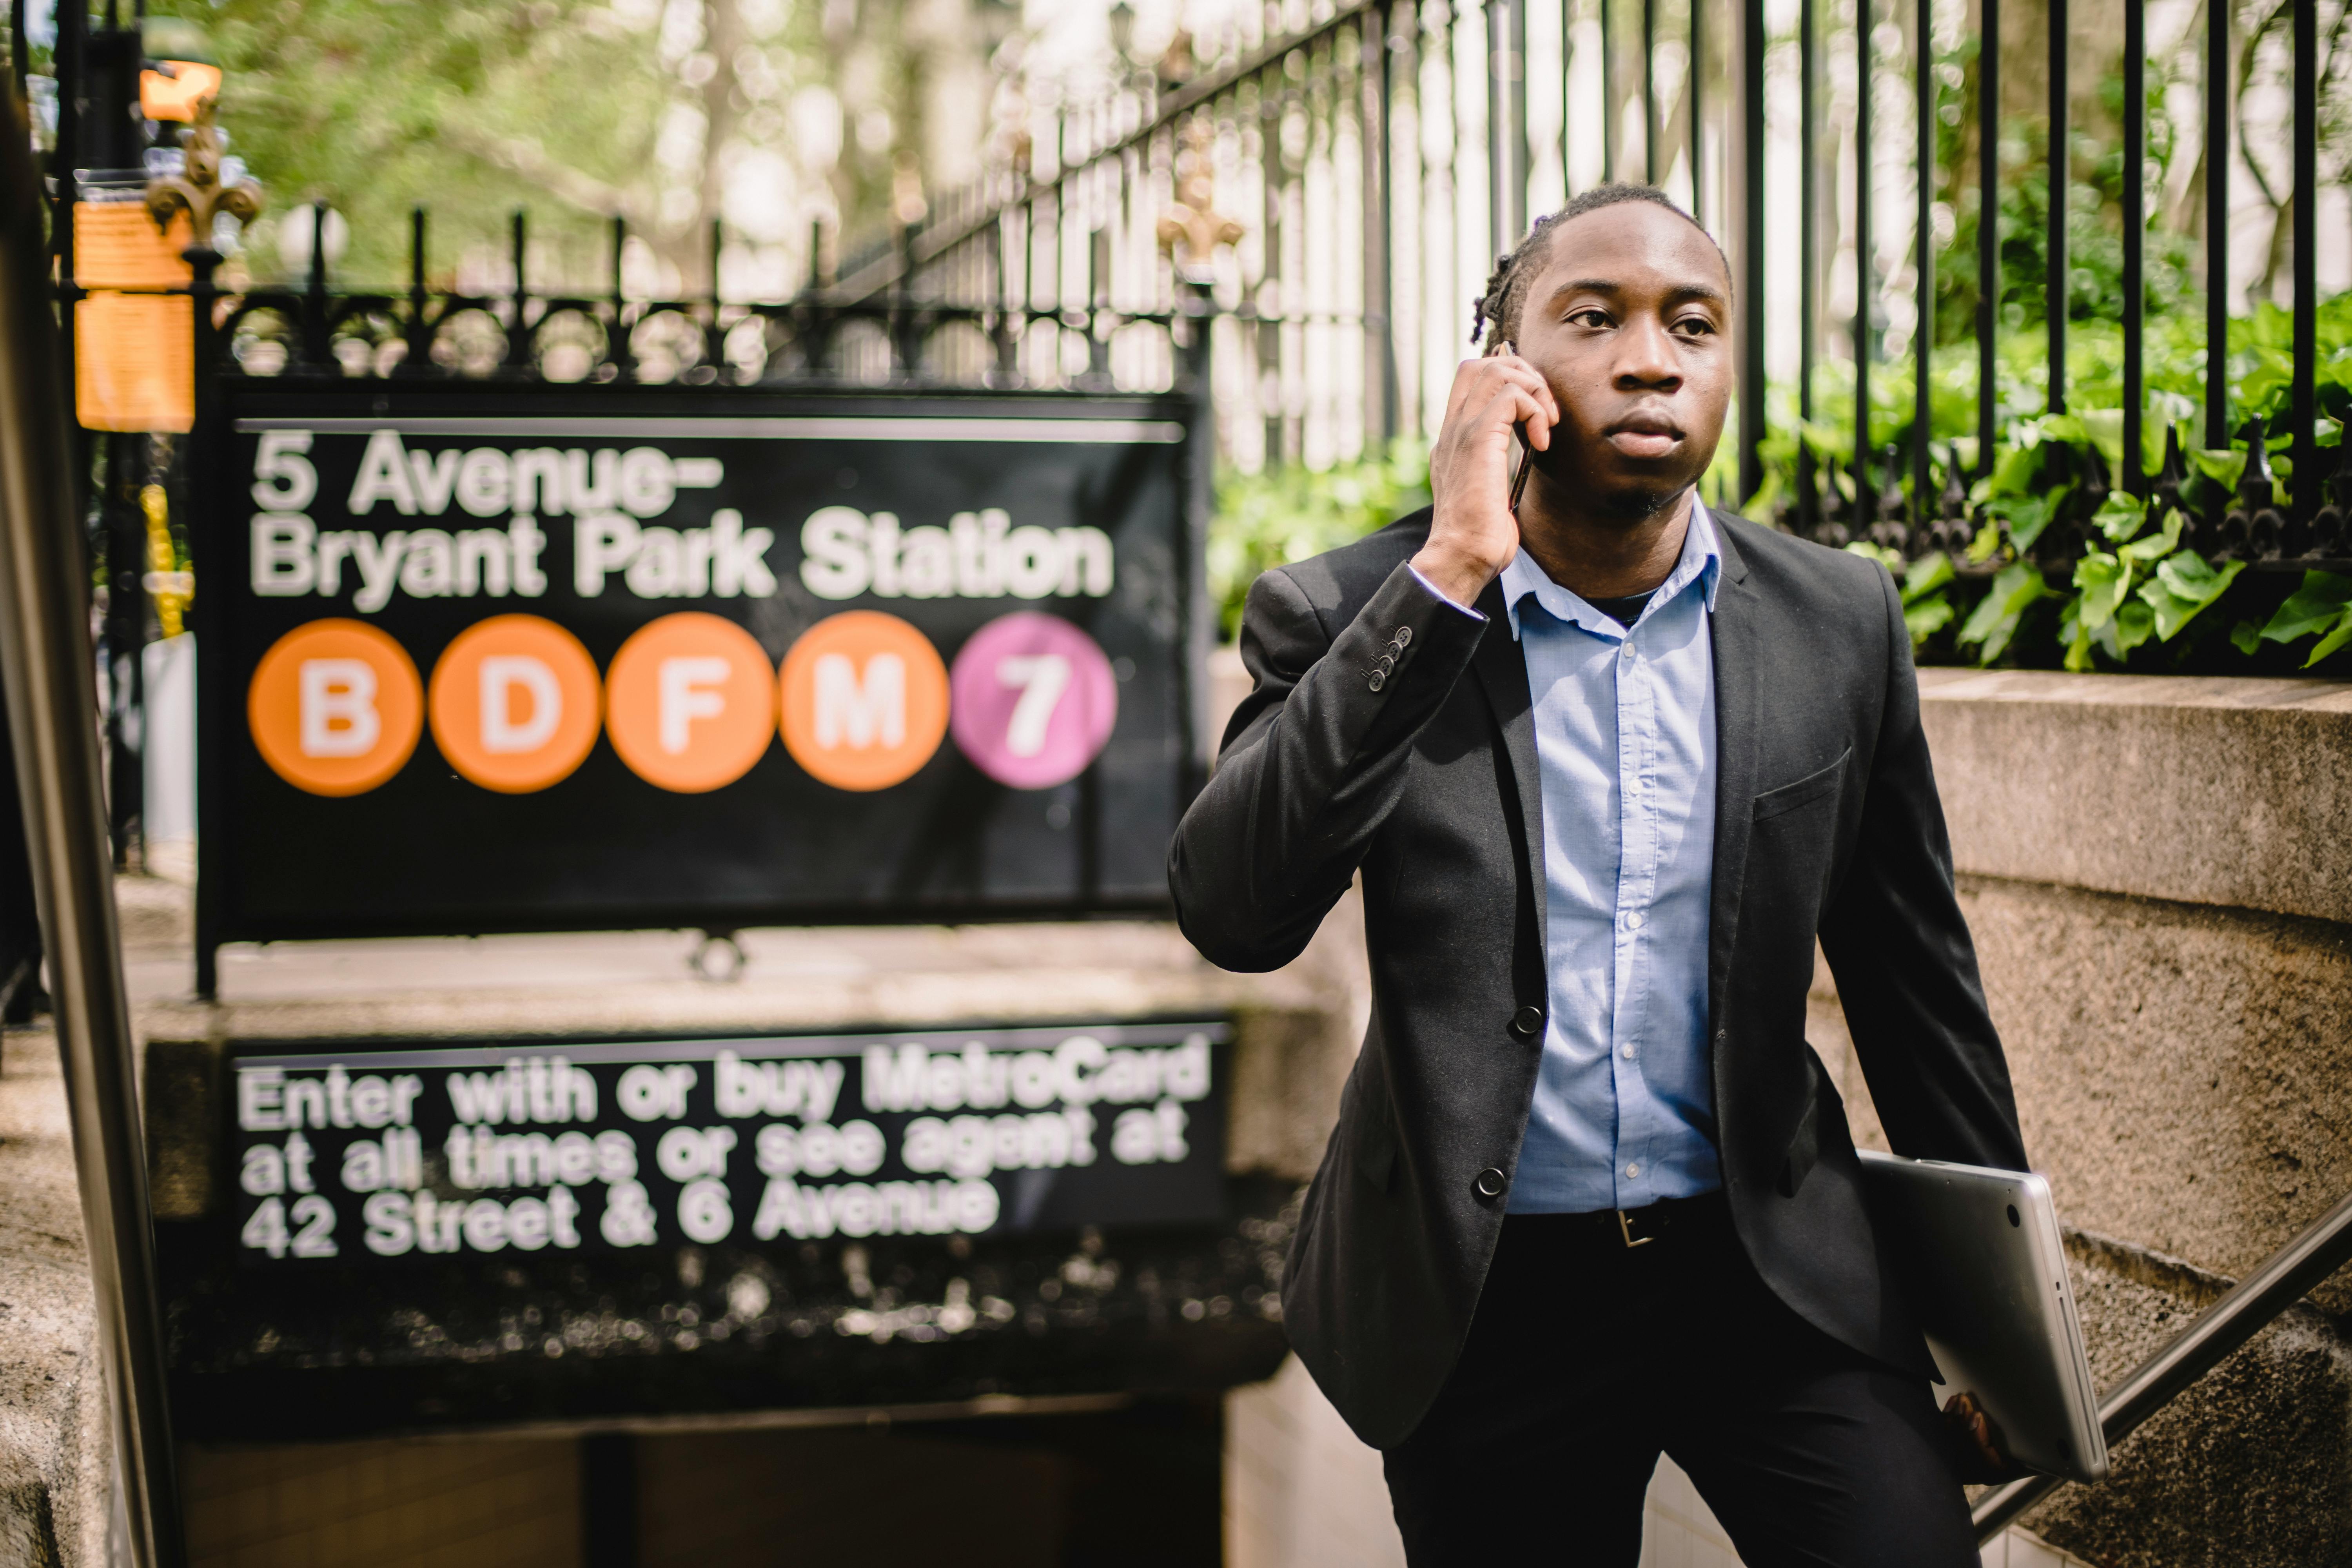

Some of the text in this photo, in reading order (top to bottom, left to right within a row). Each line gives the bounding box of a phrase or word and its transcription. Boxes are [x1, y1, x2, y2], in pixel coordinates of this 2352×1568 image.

[250, 428, 318, 513] 5
[250, 506, 1114, 613] Bryant Park Station
[300, 654, 1073, 757] B D F M 7
[237, 1033, 1212, 1131] Enter with or buy MetroCard
[240, 1098, 1189, 1196] at all times or see agent at
[240, 1176, 1000, 1259] 42 Street & 6 Avenue
